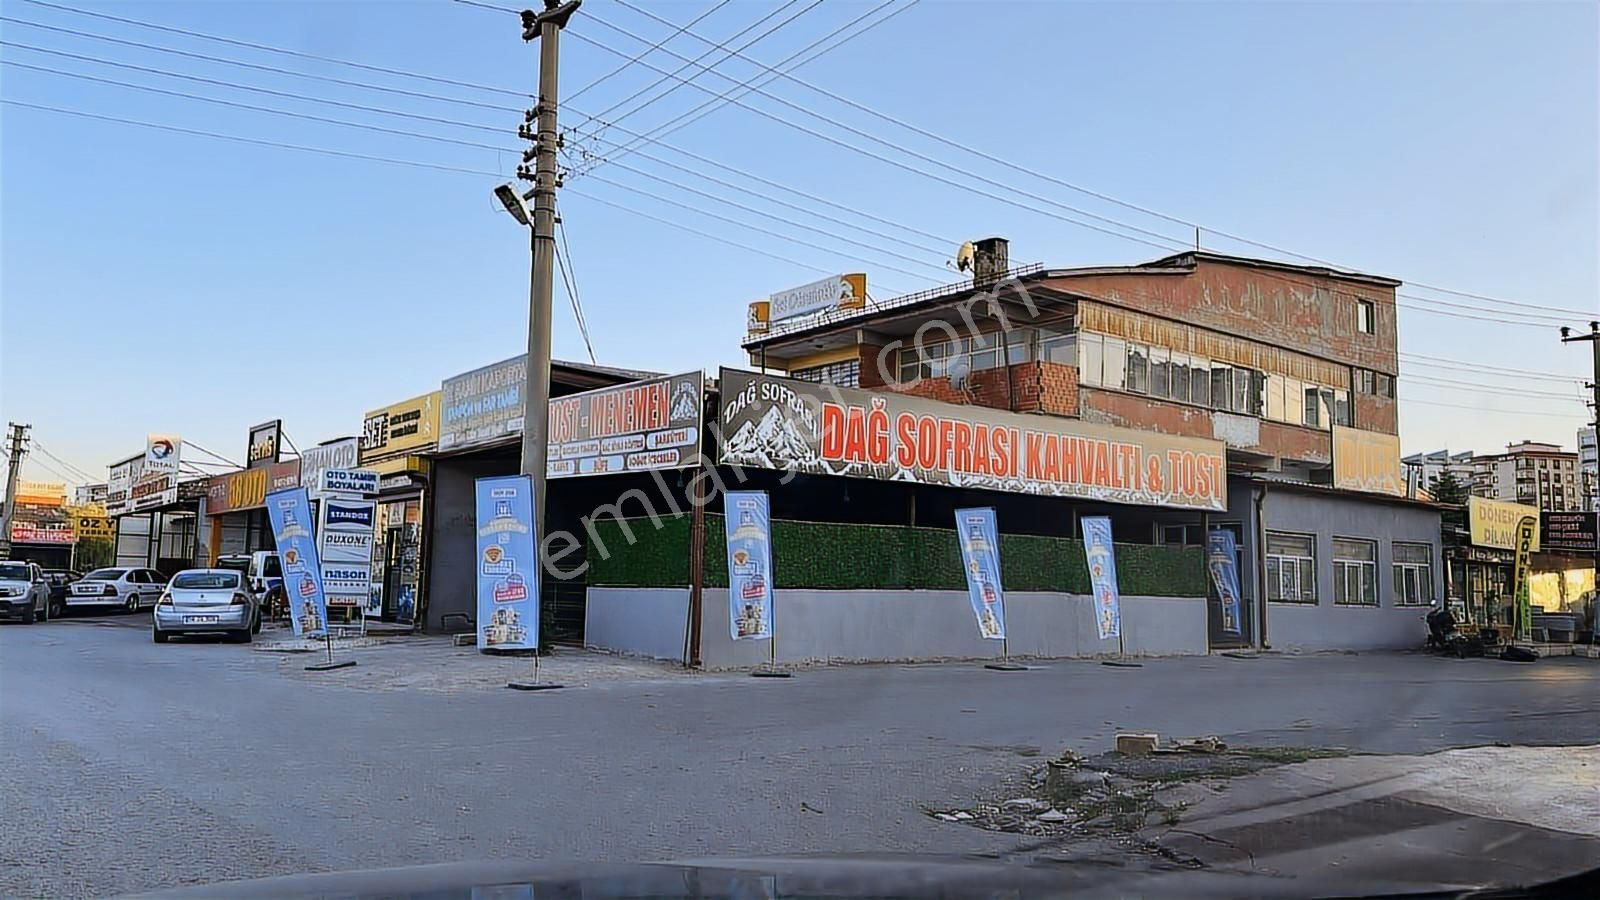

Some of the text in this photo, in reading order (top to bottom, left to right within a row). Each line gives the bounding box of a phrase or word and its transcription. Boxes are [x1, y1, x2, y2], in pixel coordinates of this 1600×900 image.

[590, 380, 670, 437] MENEMEN
[724, 380, 817, 440] DAĞ SOFRASI
[820, 396, 1223, 499] DAĞ SOFRASI KAHVALTI & TOST
[149, 460, 175, 468] TOTAL
[326, 471, 346, 480] OTO
[327, 481, 375, 491] BOYALARI
[330, 511, 368, 520] STANDOX
[326, 535, 367, 545] DUXONE
[325, 570, 366, 580] nason
